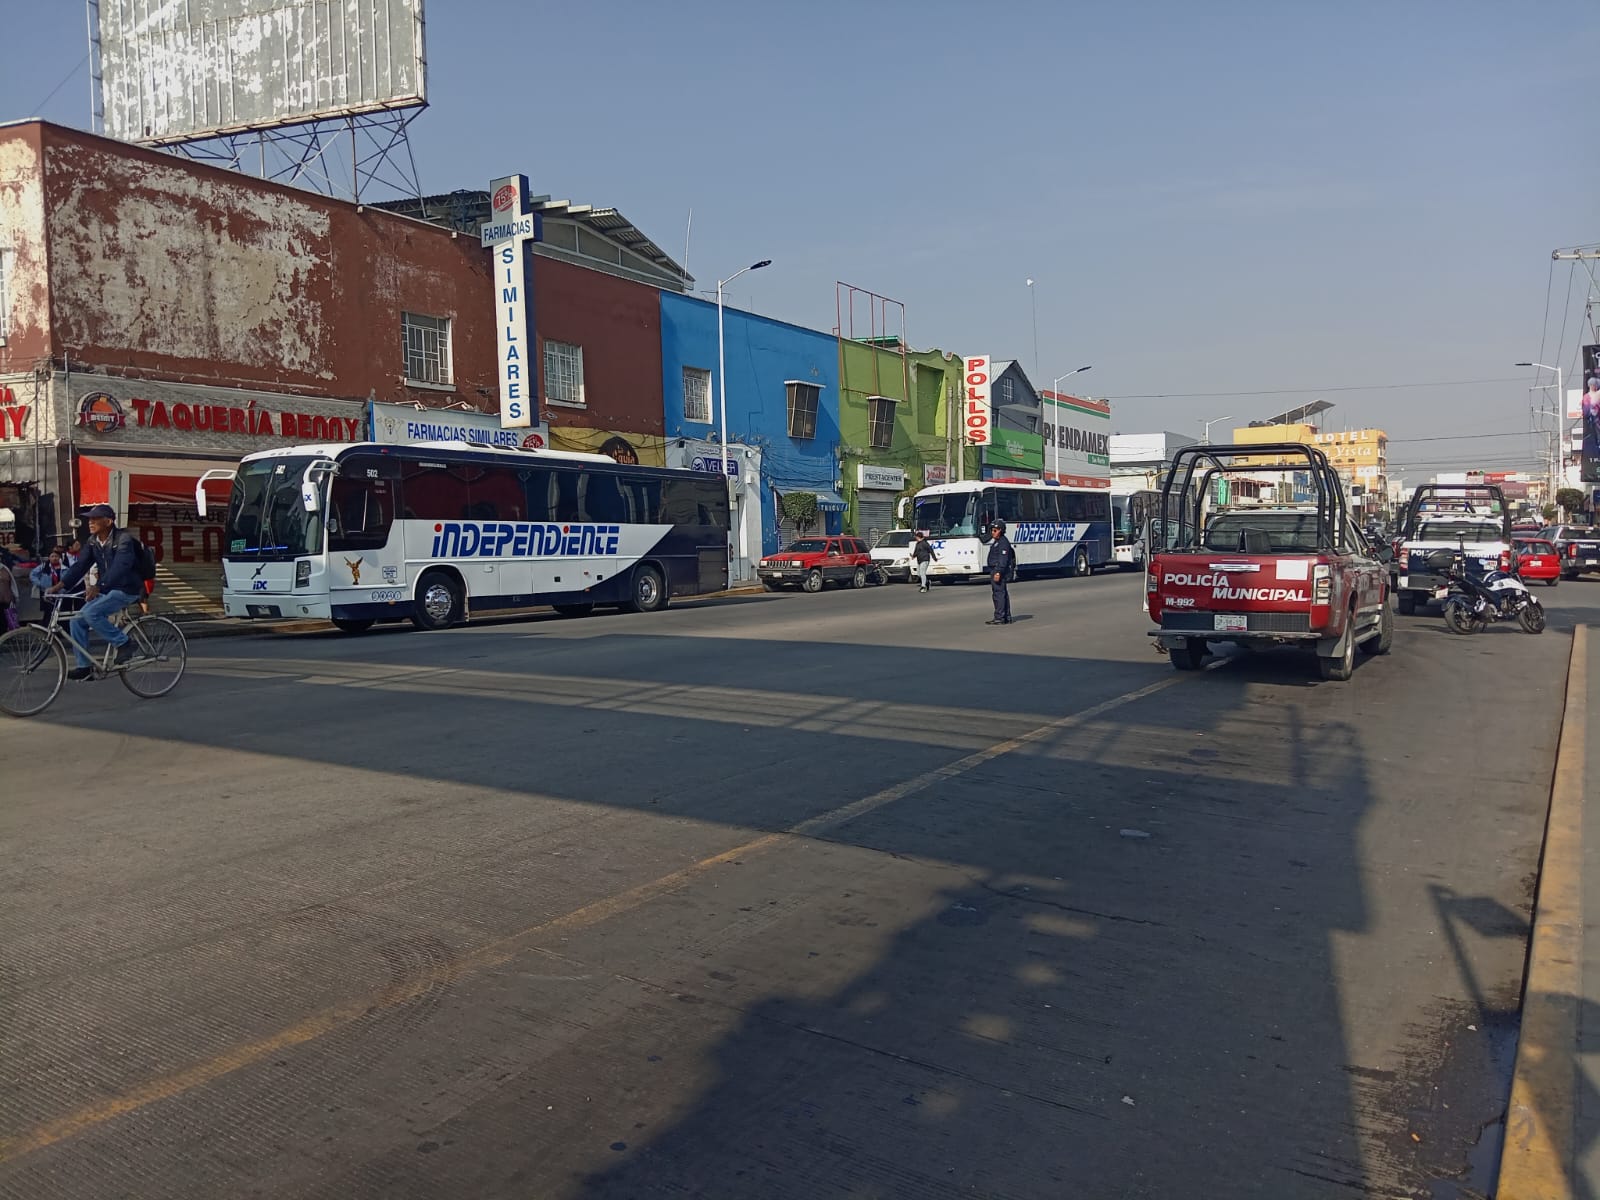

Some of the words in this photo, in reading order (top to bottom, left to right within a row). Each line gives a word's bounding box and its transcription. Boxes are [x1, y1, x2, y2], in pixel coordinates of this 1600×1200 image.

[484, 220, 530, 241] FARMACIAS
[502, 247, 522, 419] SIMILARES
[966, 358, 988, 443] POLLOS
[132, 398, 274, 436] TAQUERÍA
[407, 422, 467, 442] FARMACIAS
[468, 428, 518, 447] SIMILARES
[1314, 431, 1368, 442] HOTEL
[1335, 446, 1372, 458] Vista
[366, 469, 379, 478] 502
[1164, 572, 1229, 587] POLICÍA
[1212, 587, 1311, 602] MUNICIPAL
